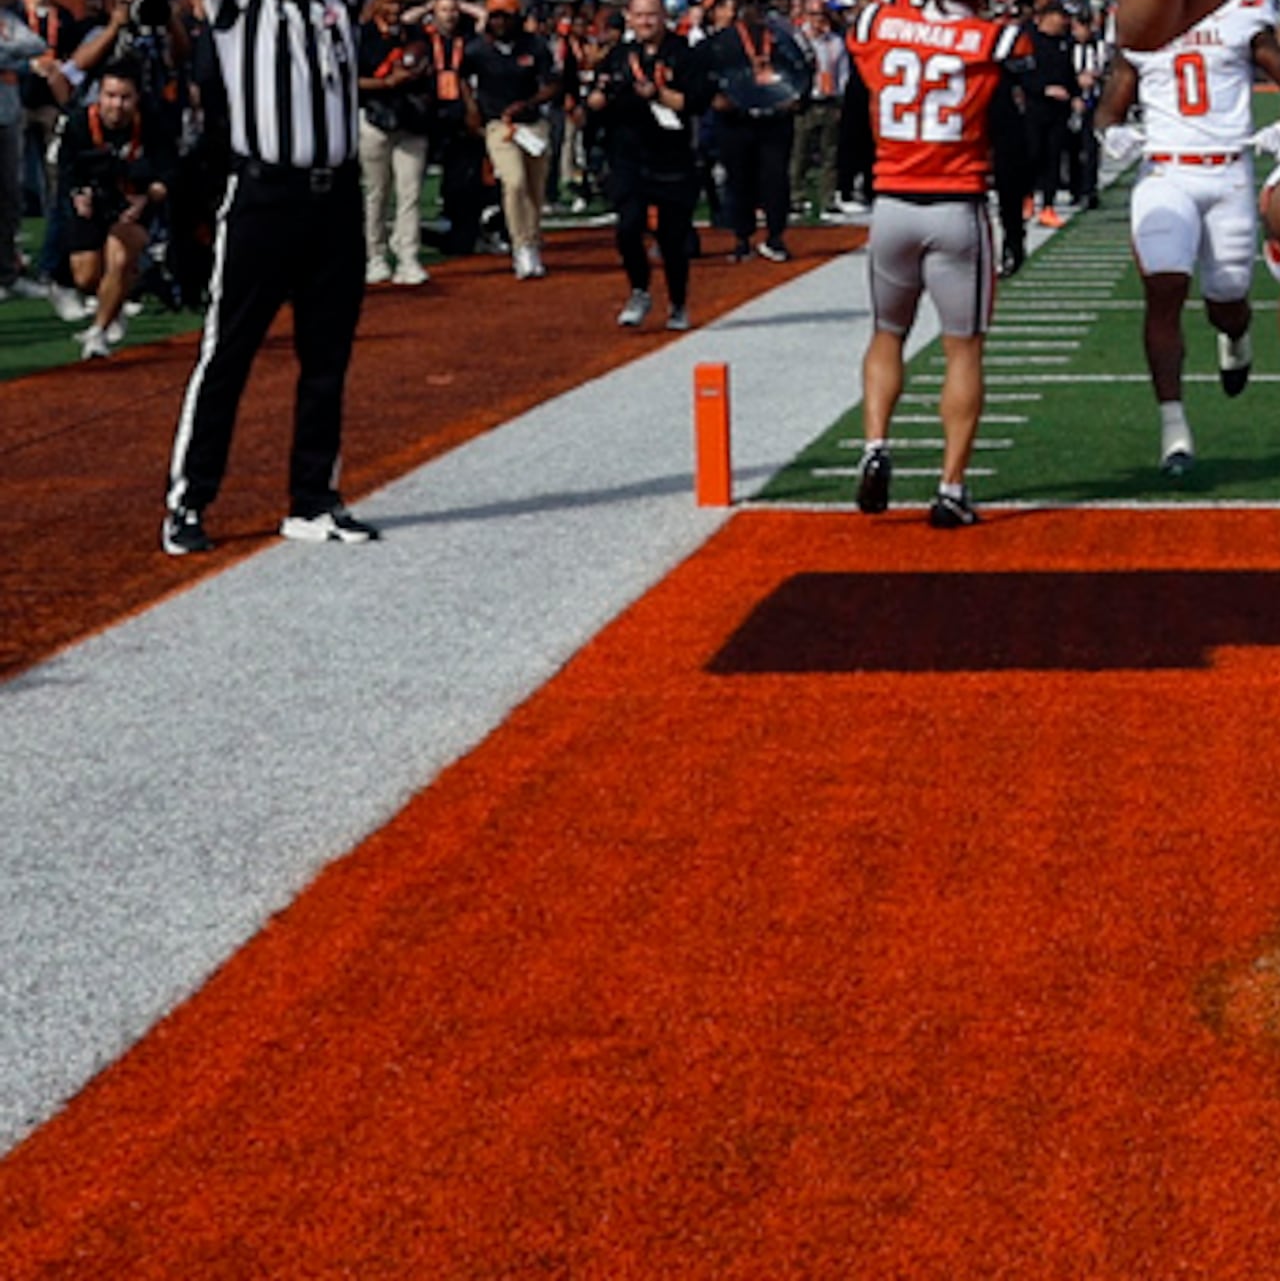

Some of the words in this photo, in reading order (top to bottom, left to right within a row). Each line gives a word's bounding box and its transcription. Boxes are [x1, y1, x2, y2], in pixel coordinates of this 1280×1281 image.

[877, 17, 955, 50] BOWMAN
[878, 48, 966, 142] 22
[1174, 51, 1210, 116] 0
